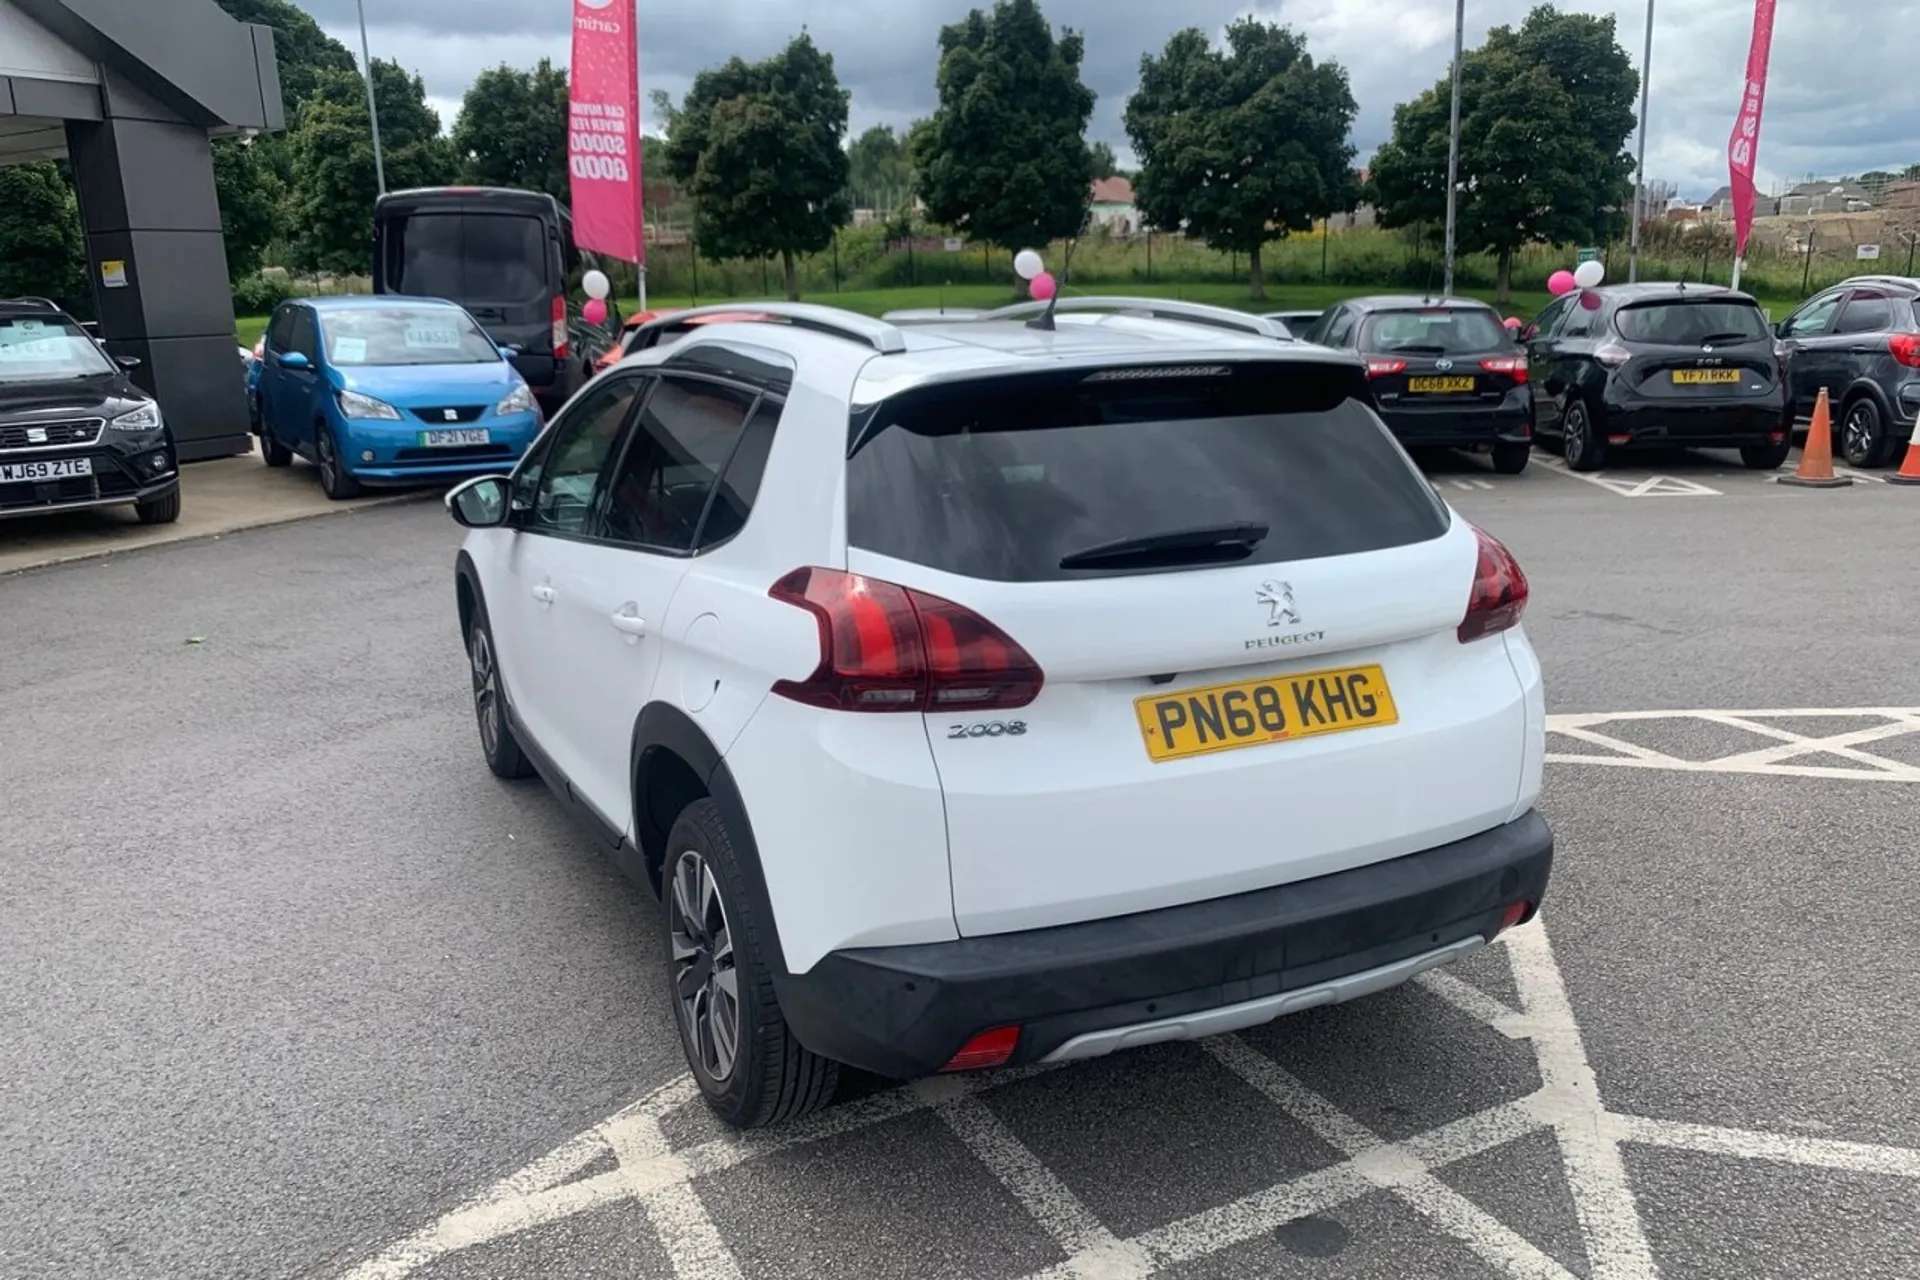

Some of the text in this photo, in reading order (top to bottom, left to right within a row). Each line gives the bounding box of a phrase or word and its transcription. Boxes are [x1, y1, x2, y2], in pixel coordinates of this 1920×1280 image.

[1681, 369, 1733, 381] YF71 RKK
[1, 459, 86, 480] WJ69 ZTE
[1244, 630, 1326, 650] PEUGEOT
[1154, 673, 1378, 750] PN68 KHG
[946, 720, 1027, 739] 2008
